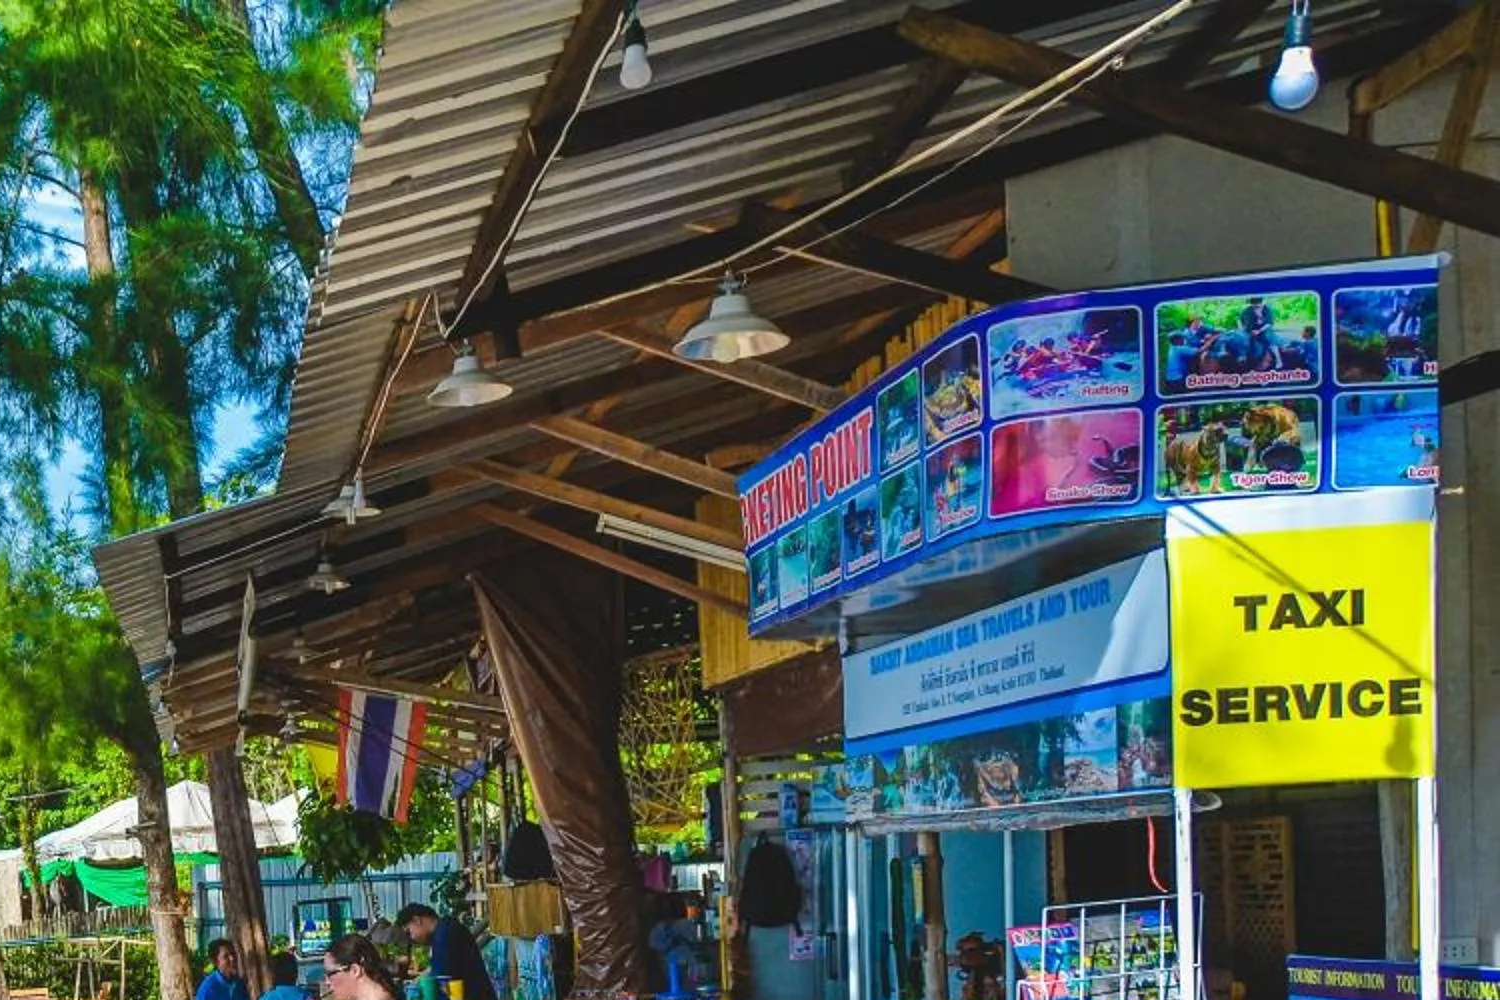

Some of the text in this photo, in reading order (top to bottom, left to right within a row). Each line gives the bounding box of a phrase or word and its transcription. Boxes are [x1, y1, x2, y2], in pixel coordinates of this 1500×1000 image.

[1080, 384, 1129, 396] Rafting
[1187, 368, 1310, 388] Bathing elephants
[810, 406, 873, 508] POINT
[1092, 483, 1130, 496] Show
[1231, 470, 1308, 487] Tiger Show
[956, 623, 978, 650] SEA
[981, 601, 1034, 641] TRAVELS
[1038, 590, 1066, 624] AND
[1069, 577, 1111, 614] TOUR
[1233, 589, 1365, 632] TAXI
[1180, 678, 1423, 727] SERVICE
[1287, 967, 1322, 984] TOURIST
[1325, 968, 1385, 991] INFORMATION
